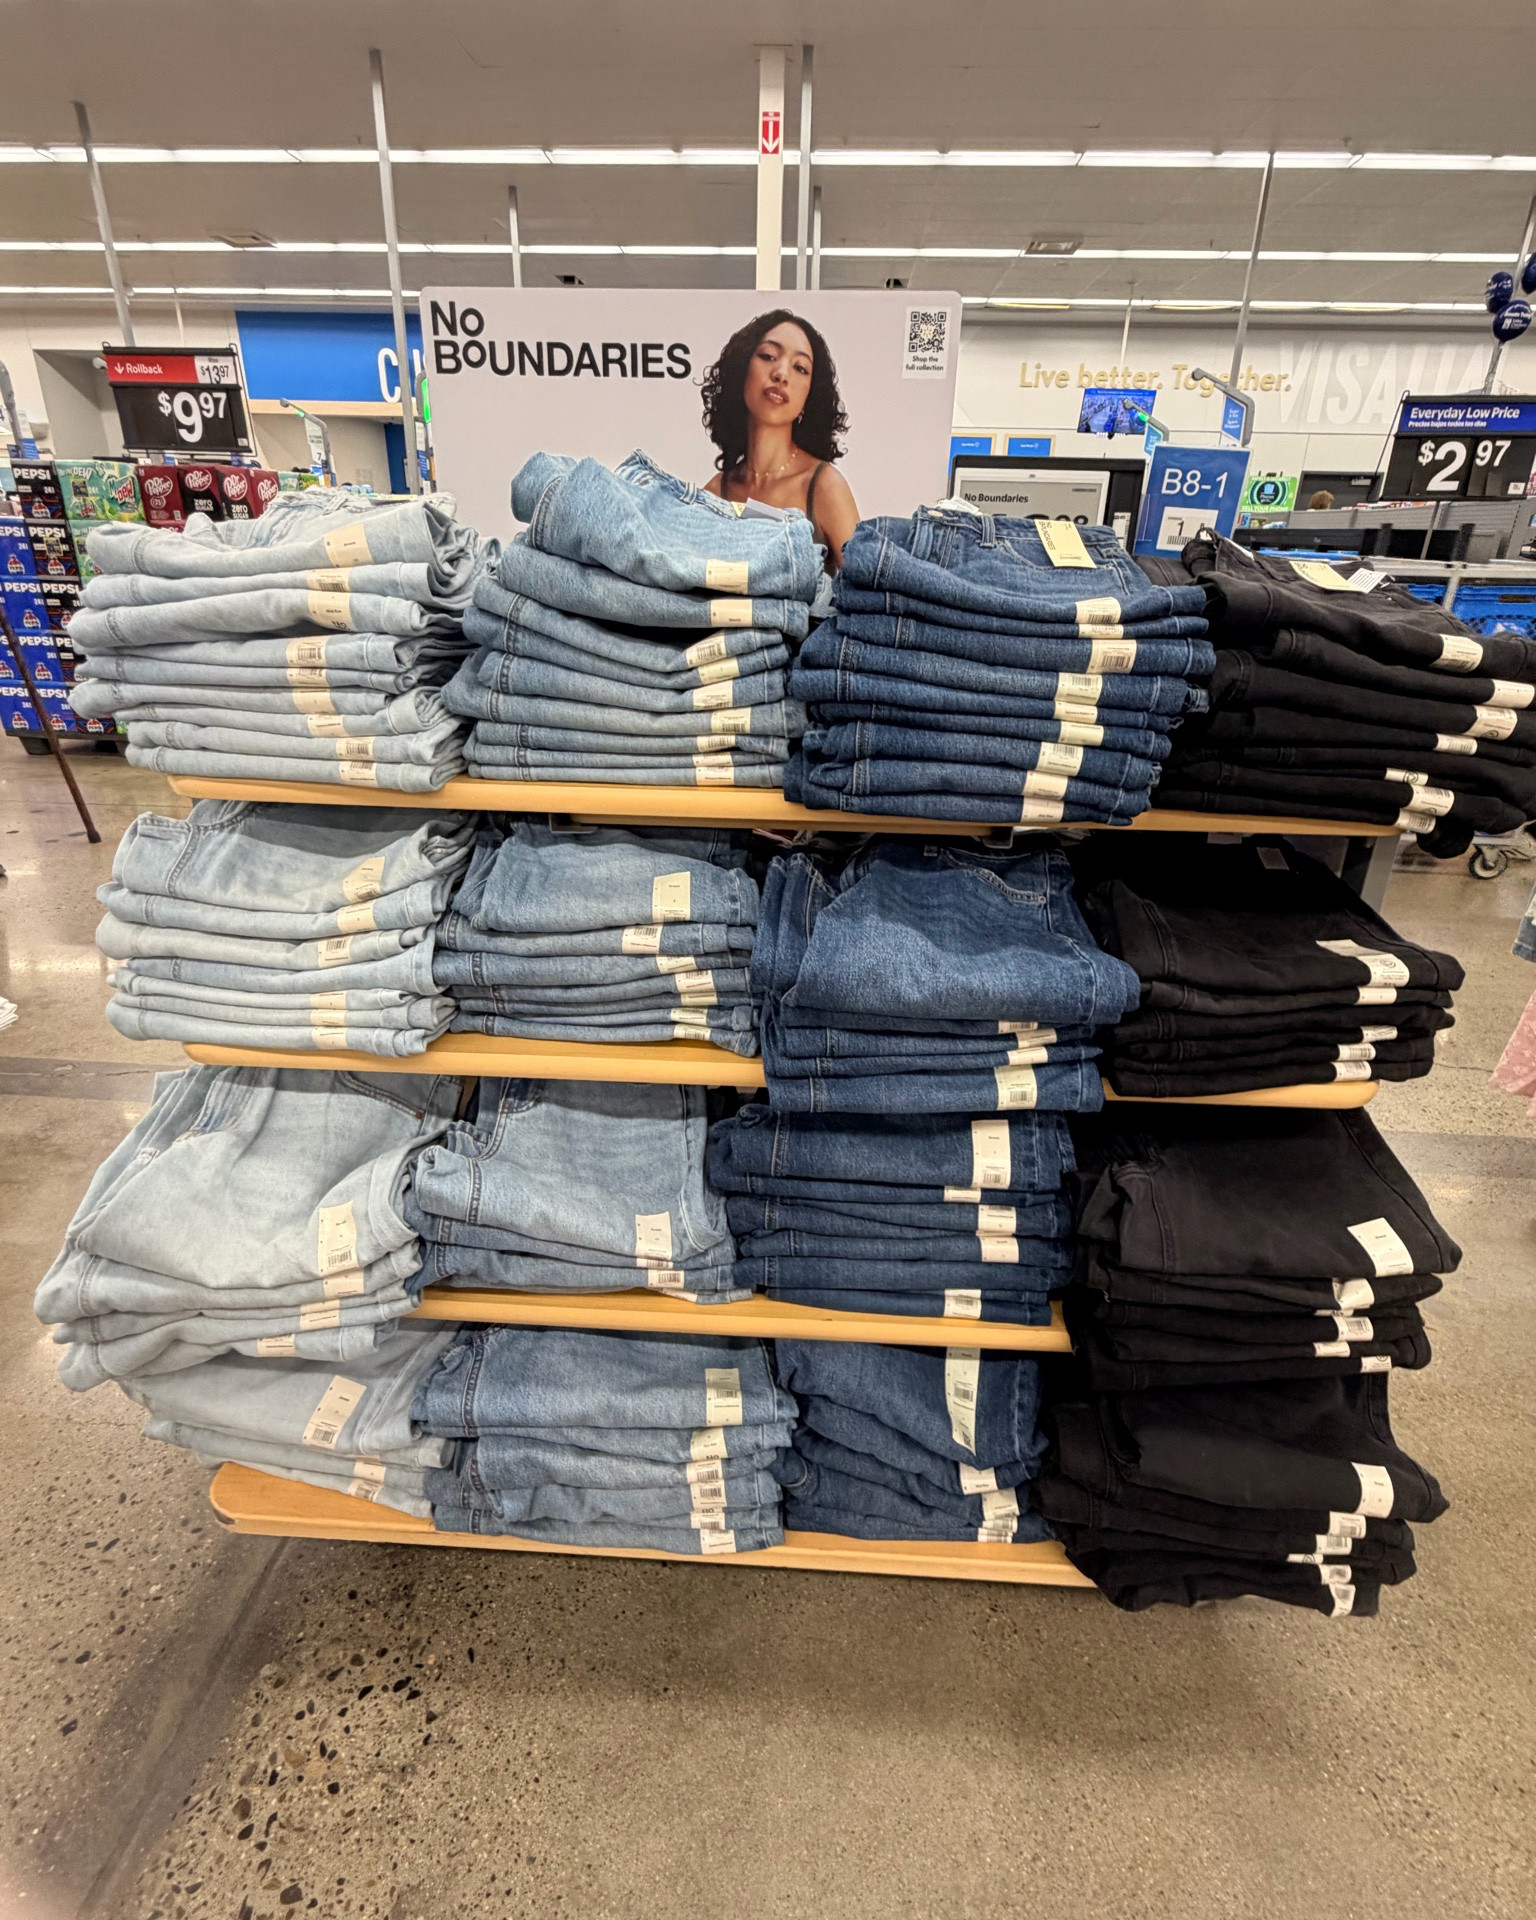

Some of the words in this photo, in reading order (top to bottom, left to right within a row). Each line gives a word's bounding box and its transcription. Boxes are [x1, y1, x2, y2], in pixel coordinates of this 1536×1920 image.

[912, 355, 928, 363] Shop
[126, 363, 163, 374] Rollback
[905, 363, 916, 371] full
[916, 363, 944, 371] collection
[1019, 362, 1070, 388] Live
[1077, 363, 1164, 389] better.
[1410, 406, 1465, 420] Everyday
[1466, 406, 1491, 418] Low
[1491, 406, 1520, 419] Price
[13, 468, 51, 480] PEPSI
[188, 472, 210, 488] Pepper
[147, 480, 171, 496] Pepper
[226, 477, 246, 497] Pepper
[1161, 468, 1228, 498] B8-1
[964, 493, 977, 501] No
[978, 493, 1028, 503] Boundaries
[28, 526, 66, 538] PEPSI
[4, 582, 41, 593] PEPSI
[42, 582, 80, 594] PEPSI
[18, 636, 54, 646] PEPSI
